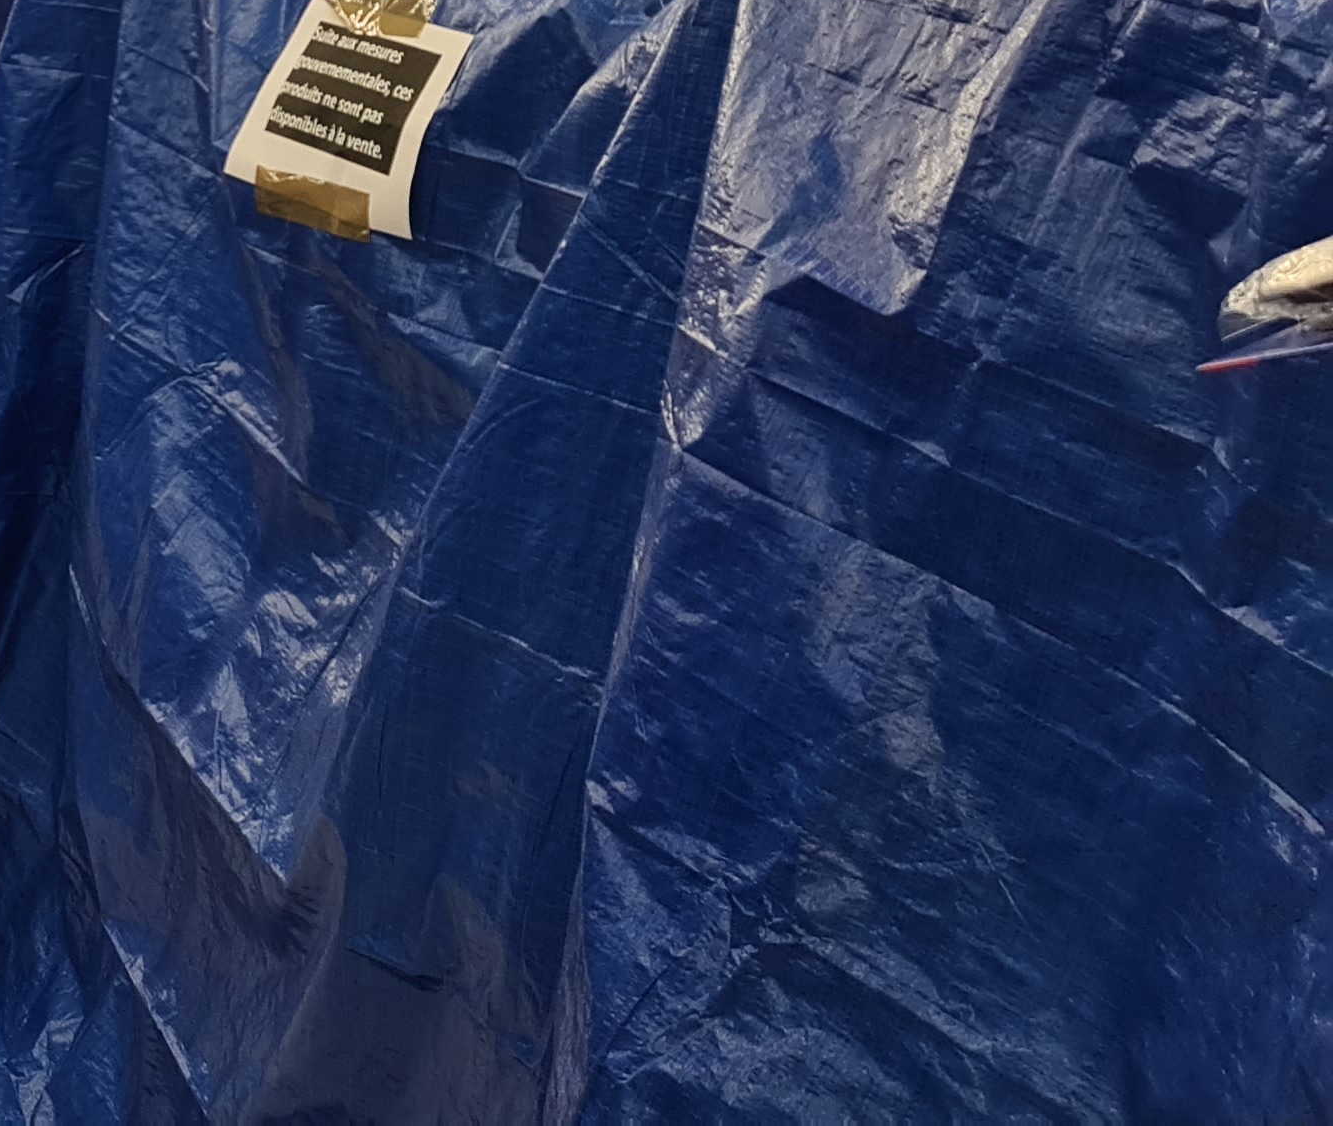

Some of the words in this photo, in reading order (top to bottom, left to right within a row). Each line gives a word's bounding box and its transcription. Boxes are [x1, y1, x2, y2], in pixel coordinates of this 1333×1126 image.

[313, 25, 339, 45] Suite
[337, 35, 358, 52] aux
[356, 40, 405, 65] mesures
[294, 53, 392, 98] gouvernementales,
[392, 83, 415, 103] ces
[281, 80, 324, 105] produits
[322, 93, 339, 109] ne
[337, 97, 365, 119] sont
[360, 106, 385, 126] pas
[269, 104, 329, 140] disponibles
[335, 126, 346, 146] la
[346, 133, 384, 161] vente.
